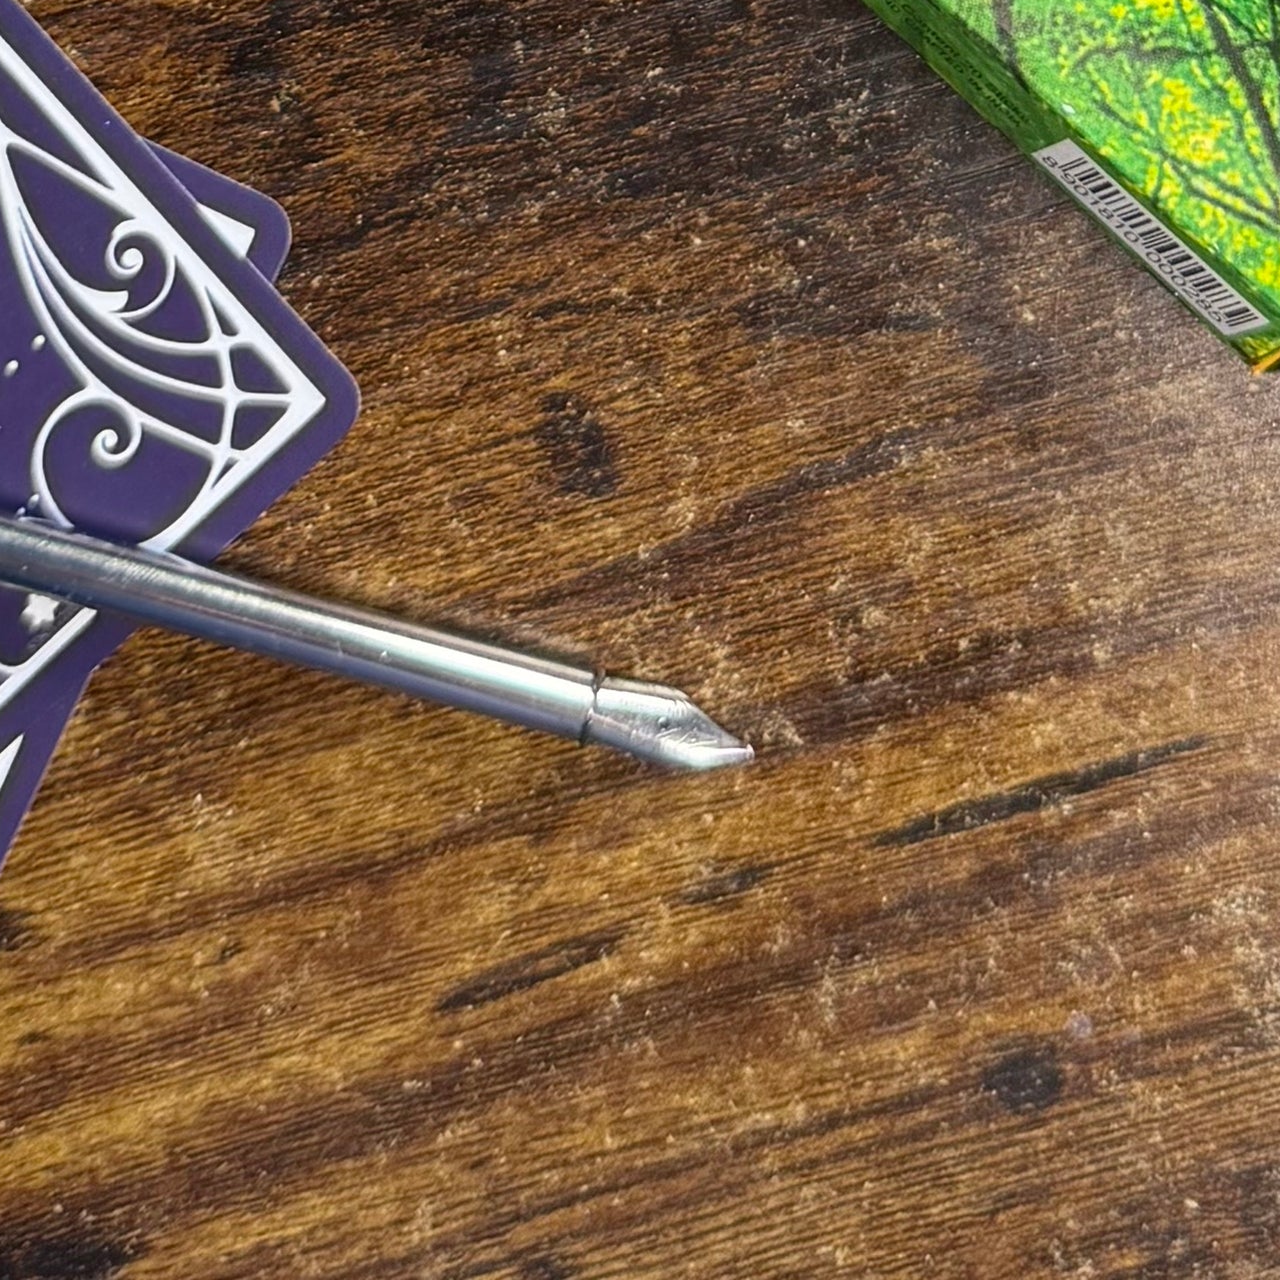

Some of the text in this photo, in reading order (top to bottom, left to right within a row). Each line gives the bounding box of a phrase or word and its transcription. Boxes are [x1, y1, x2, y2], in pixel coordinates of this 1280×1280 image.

[1042, 155, 1224, 323] 8 901810 000285
